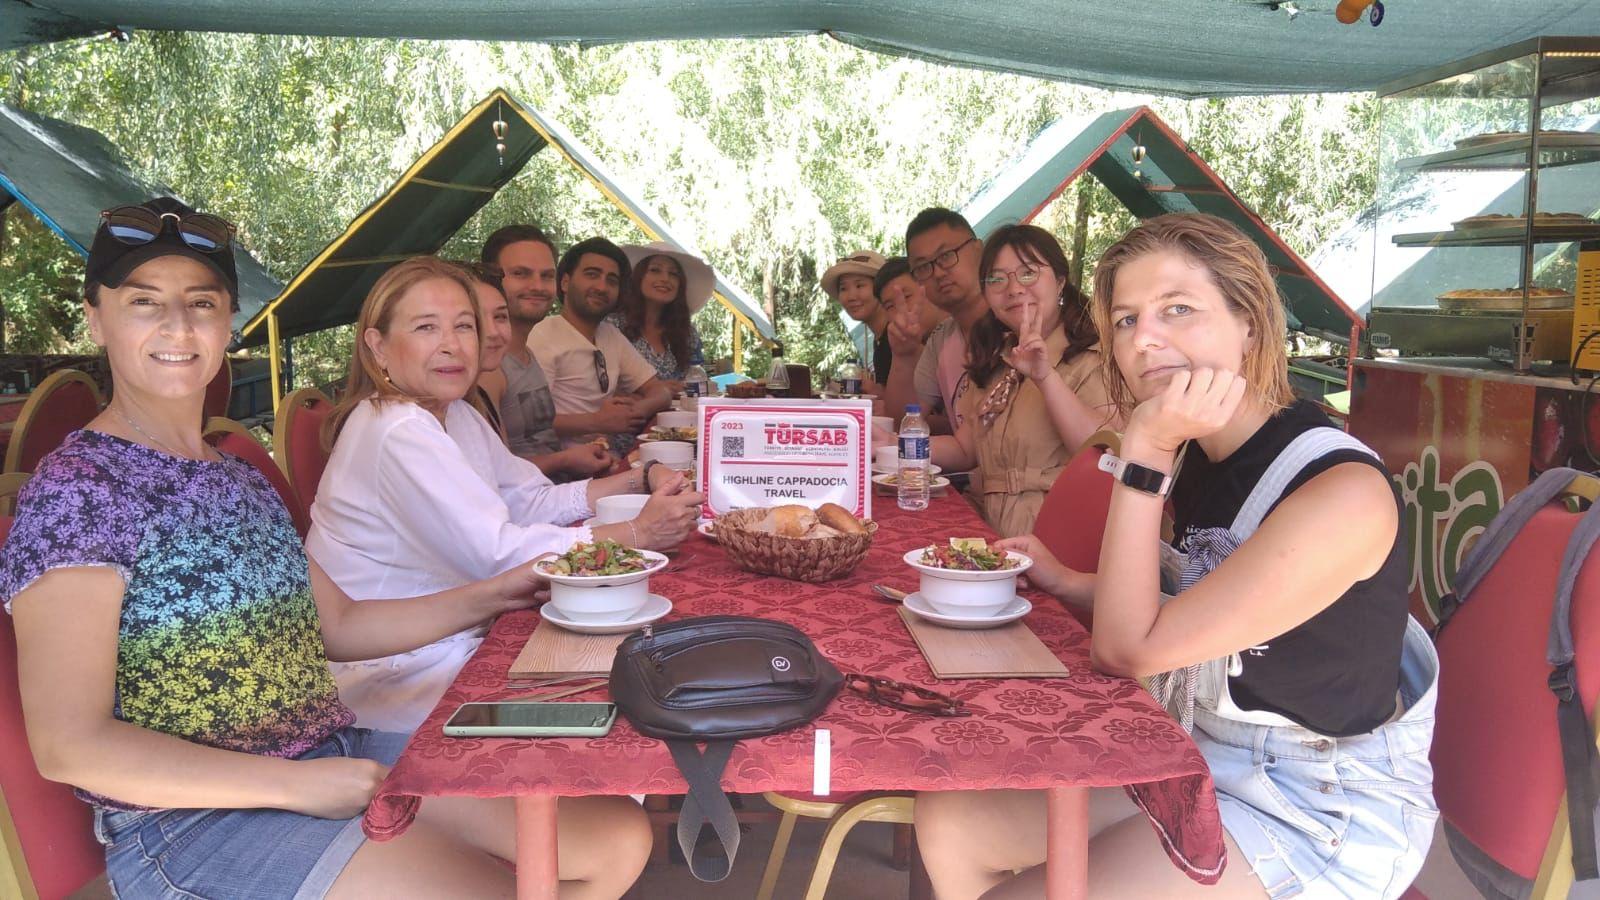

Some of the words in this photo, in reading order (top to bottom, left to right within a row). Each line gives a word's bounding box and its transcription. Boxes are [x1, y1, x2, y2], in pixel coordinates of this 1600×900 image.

[721, 422, 744, 430] 2023
[764, 423, 848, 445] TÜRSAB
[723, 475, 774, 485] HIGHLINE
[776, 476, 848, 486] CAPPADOCIA
[764, 488, 806, 498] TRAVEL
